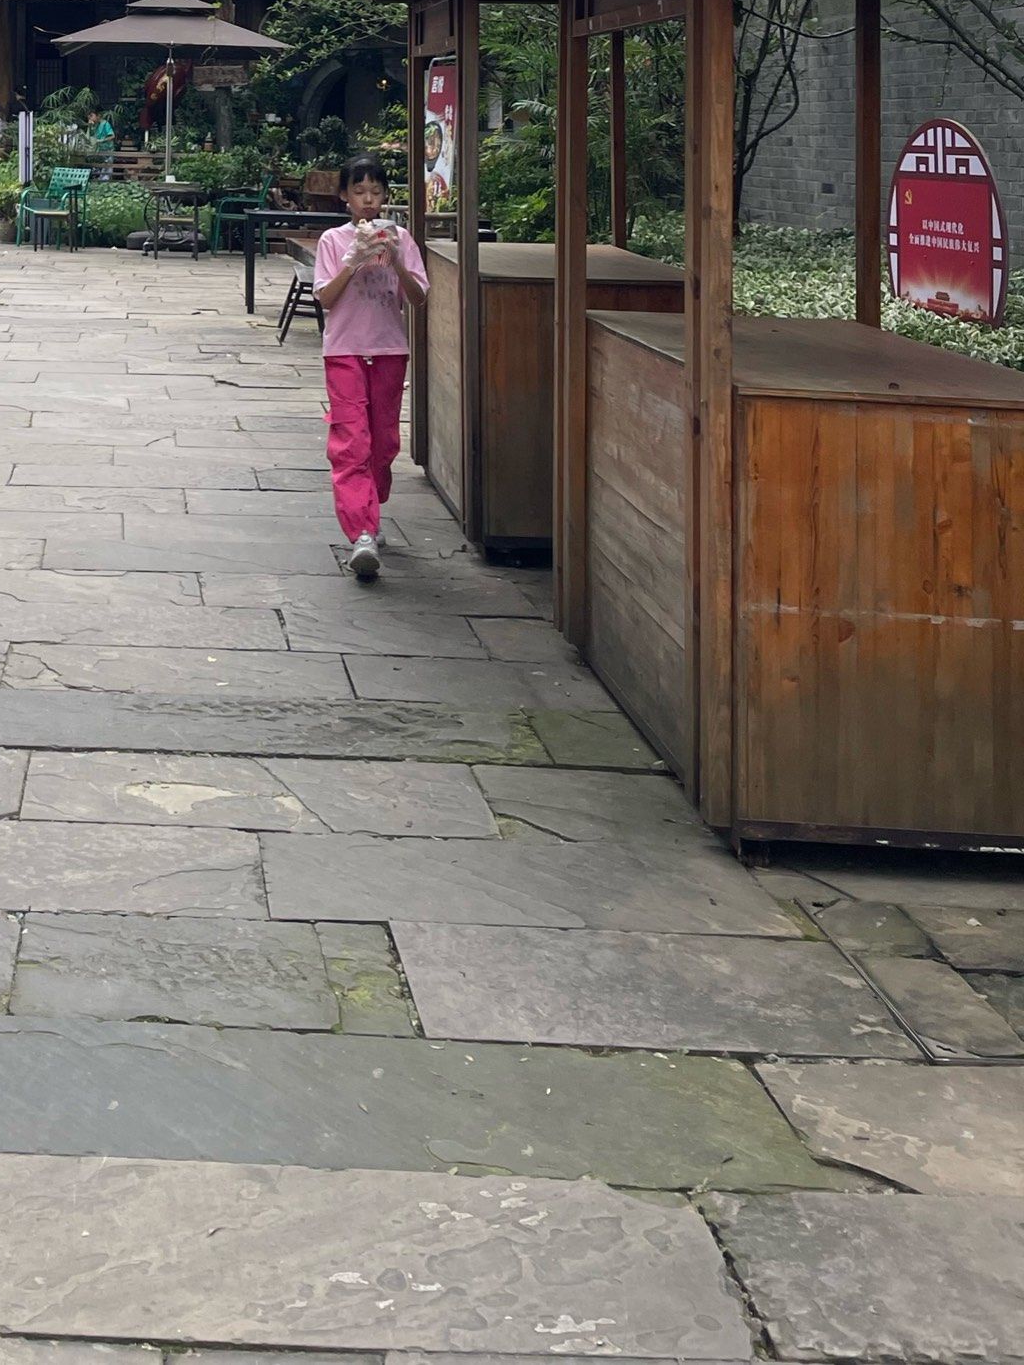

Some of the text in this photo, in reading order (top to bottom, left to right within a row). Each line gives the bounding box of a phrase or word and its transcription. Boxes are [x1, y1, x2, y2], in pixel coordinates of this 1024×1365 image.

[922, 219, 964, 234] 以中国式现代化
